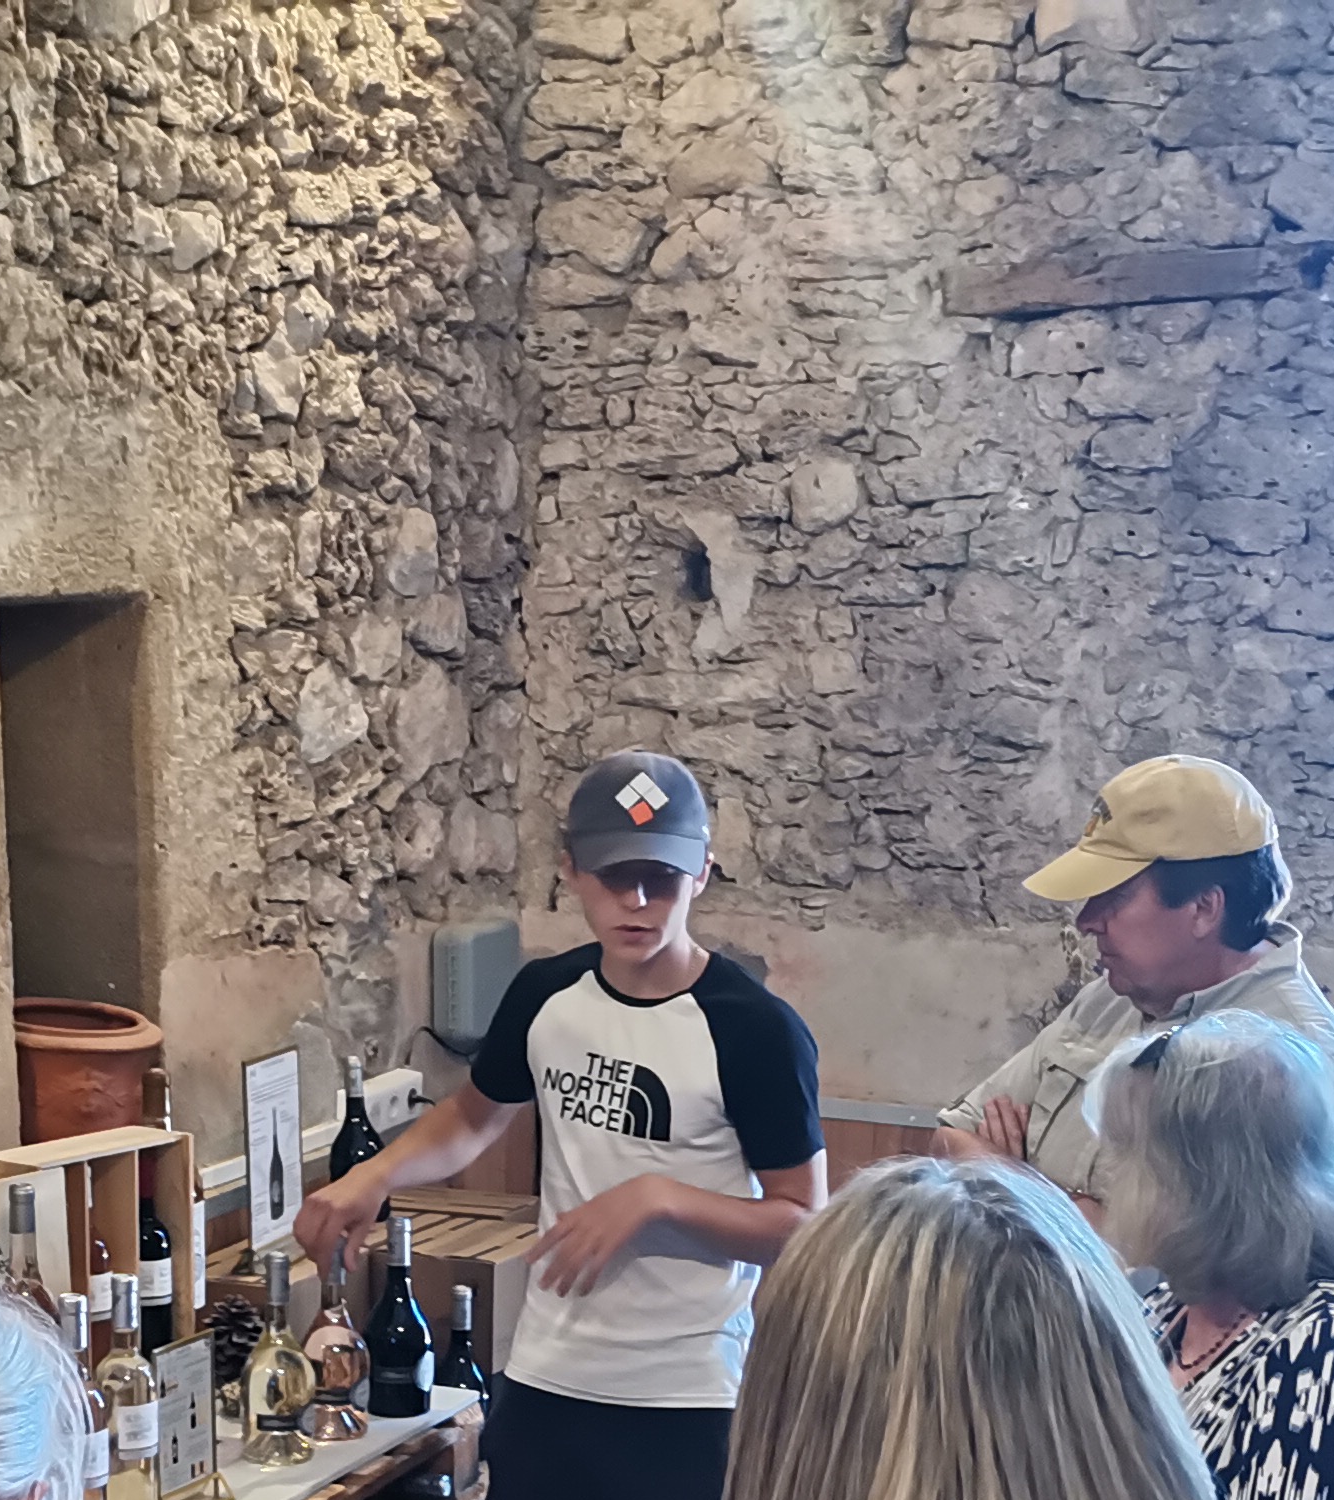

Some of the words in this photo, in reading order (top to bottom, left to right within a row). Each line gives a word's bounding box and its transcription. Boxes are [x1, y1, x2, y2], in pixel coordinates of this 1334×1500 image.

[587, 1051, 633, 1084] THE
[542, 1066, 627, 1109] NORTH
[560, 1096, 622, 1132] FACE
